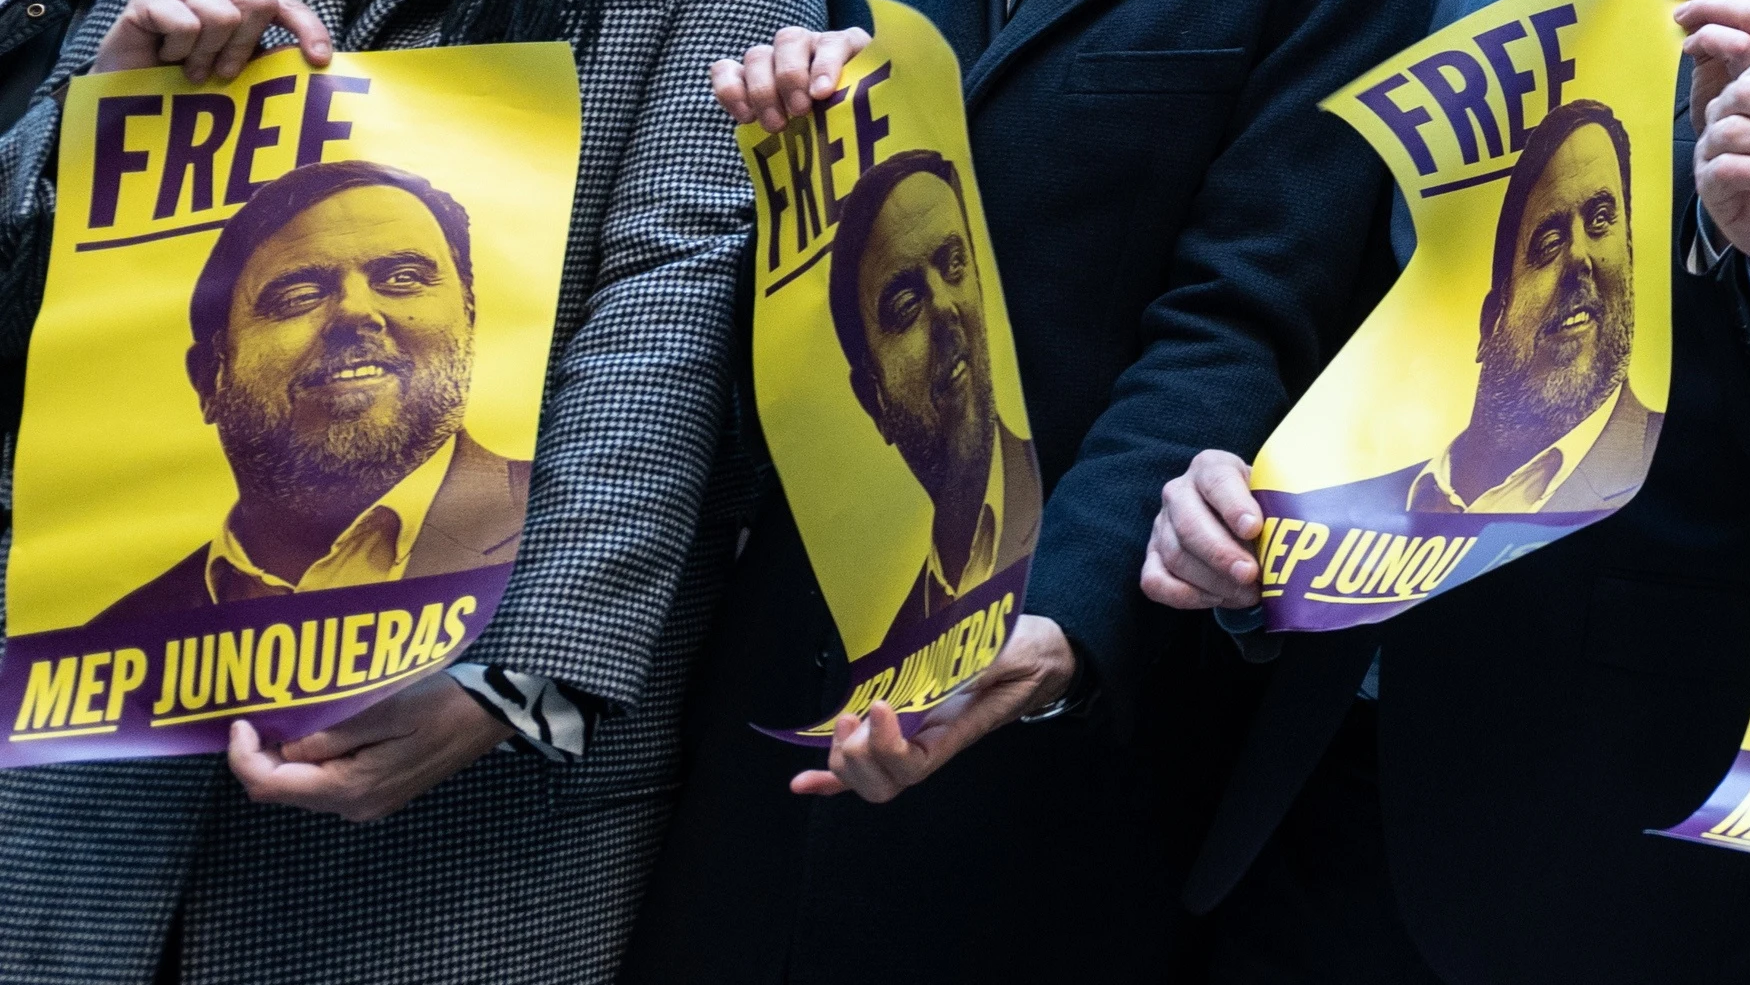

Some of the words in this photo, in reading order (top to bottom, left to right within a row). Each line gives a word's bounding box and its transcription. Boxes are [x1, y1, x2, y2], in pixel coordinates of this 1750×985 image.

[87, 73, 371, 230] FREE
[752, 59, 892, 273] FREE
[1357, 3, 1579, 176] FREE
[1310, 528, 1480, 598] JUNQU
[13, 647, 148, 732] MEP
[152, 594, 478, 716] JUNQUERAS
